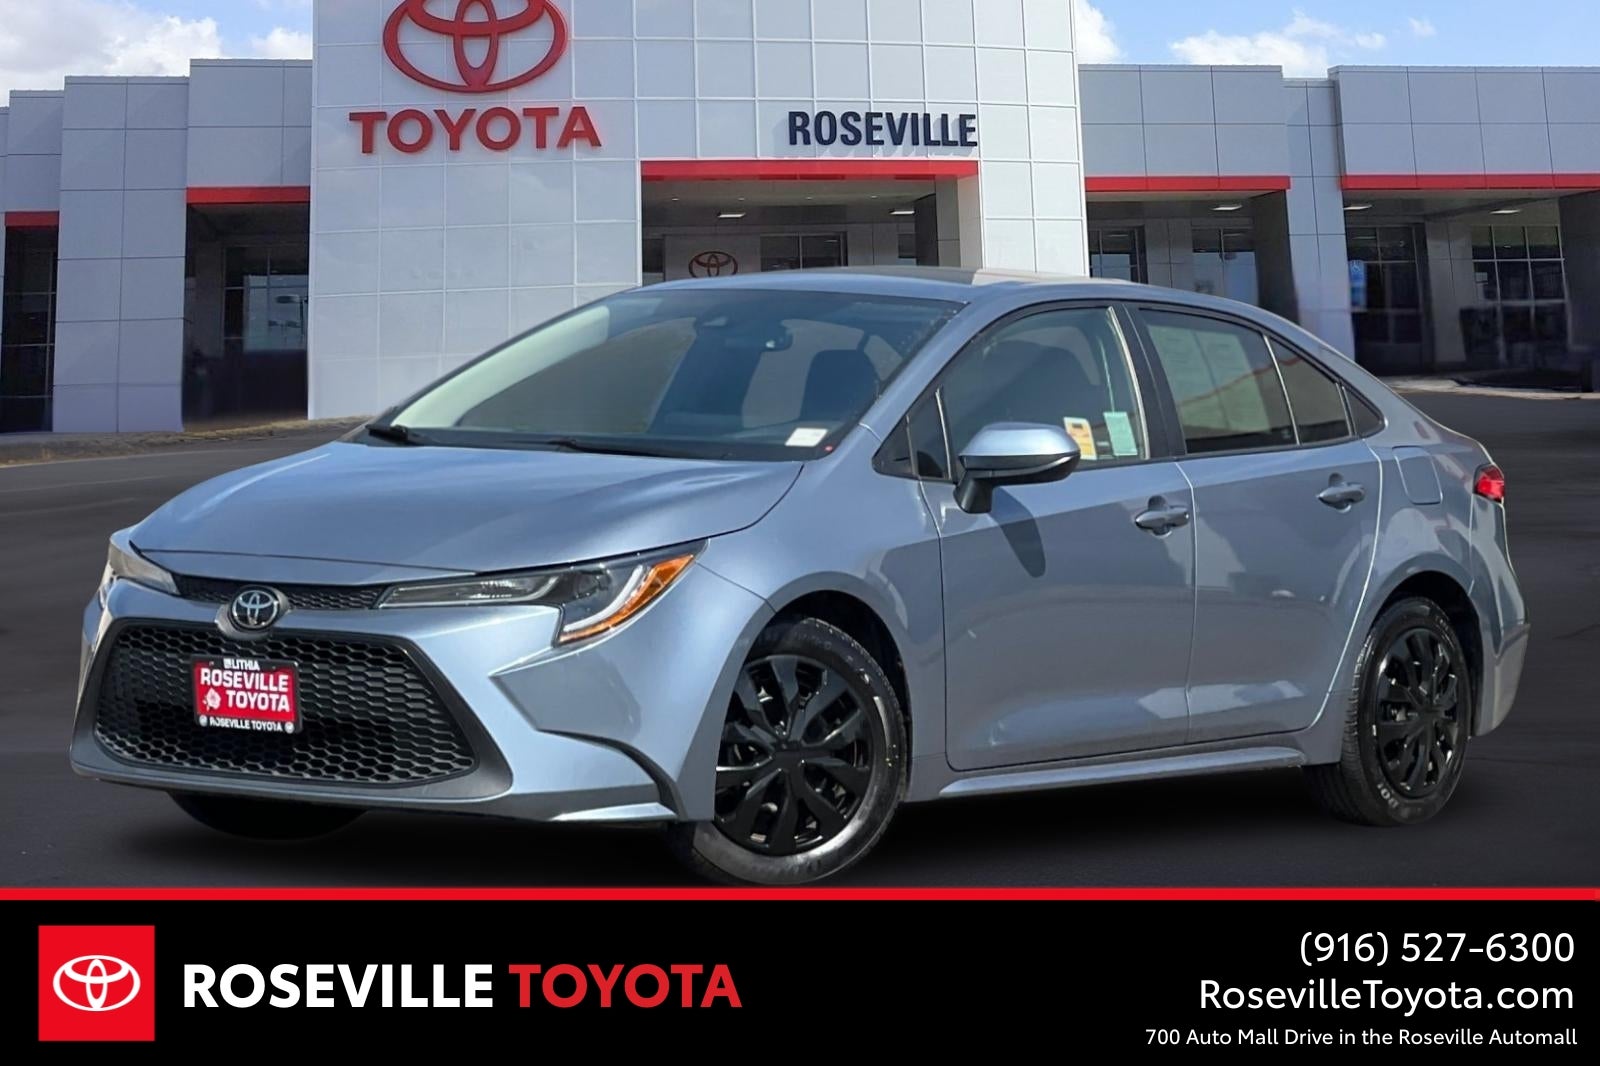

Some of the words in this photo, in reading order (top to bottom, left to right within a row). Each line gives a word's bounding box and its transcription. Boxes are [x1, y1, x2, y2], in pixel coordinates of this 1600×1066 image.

[349, 106, 602, 155] TOYOTA
[788, 110, 978, 148] ROSEVILLE
[200, 667, 289, 692] ROSEVILLE
[225, 689, 290, 713] TOYOTA
[251, 720, 284, 732] TOYOTA
